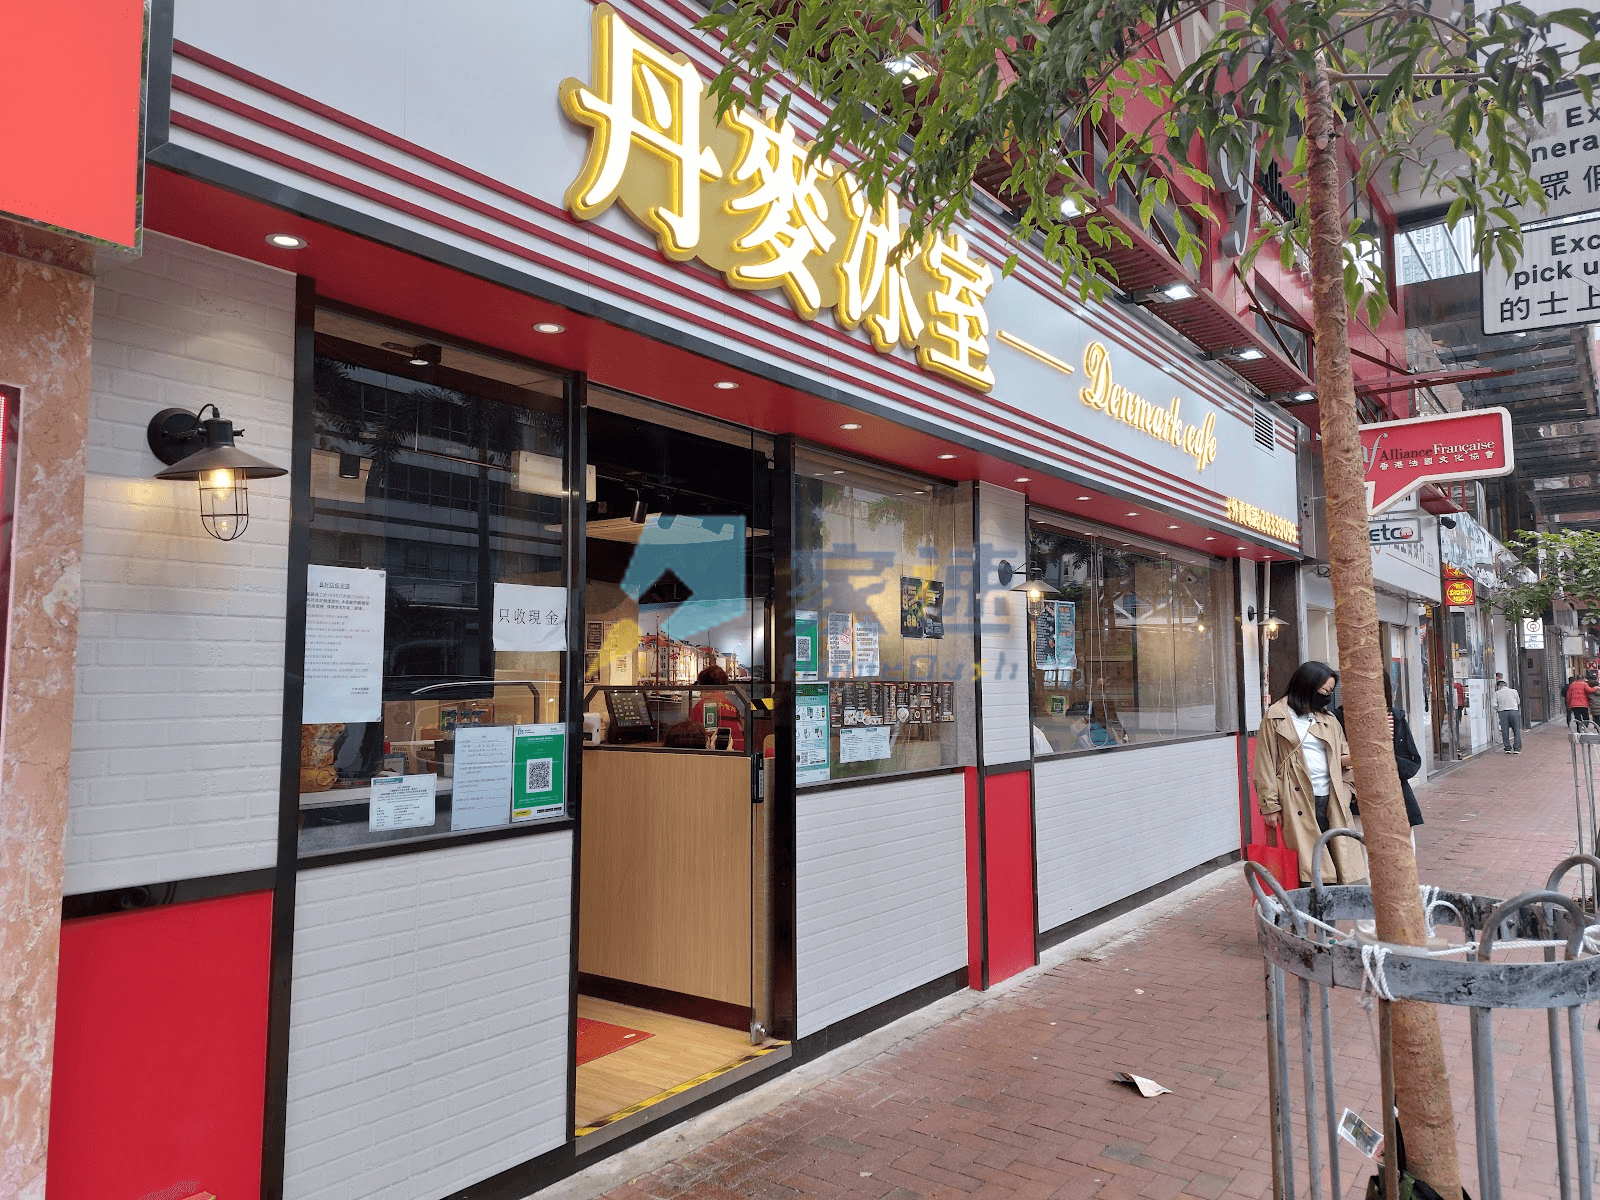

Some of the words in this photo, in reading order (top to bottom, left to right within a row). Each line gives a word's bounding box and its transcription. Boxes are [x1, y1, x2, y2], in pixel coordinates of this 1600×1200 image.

[559, 3, 995, 393] 丹麥冰室
[1514, 260, 1573, 290] pick
[1500, 285, 1600, 323] 的士上
[1079, 341, 1183, 447] Denmark
[1379, 450, 1496, 471] 香港法國文化協會
[498, 608, 559, 625] 只收現金
